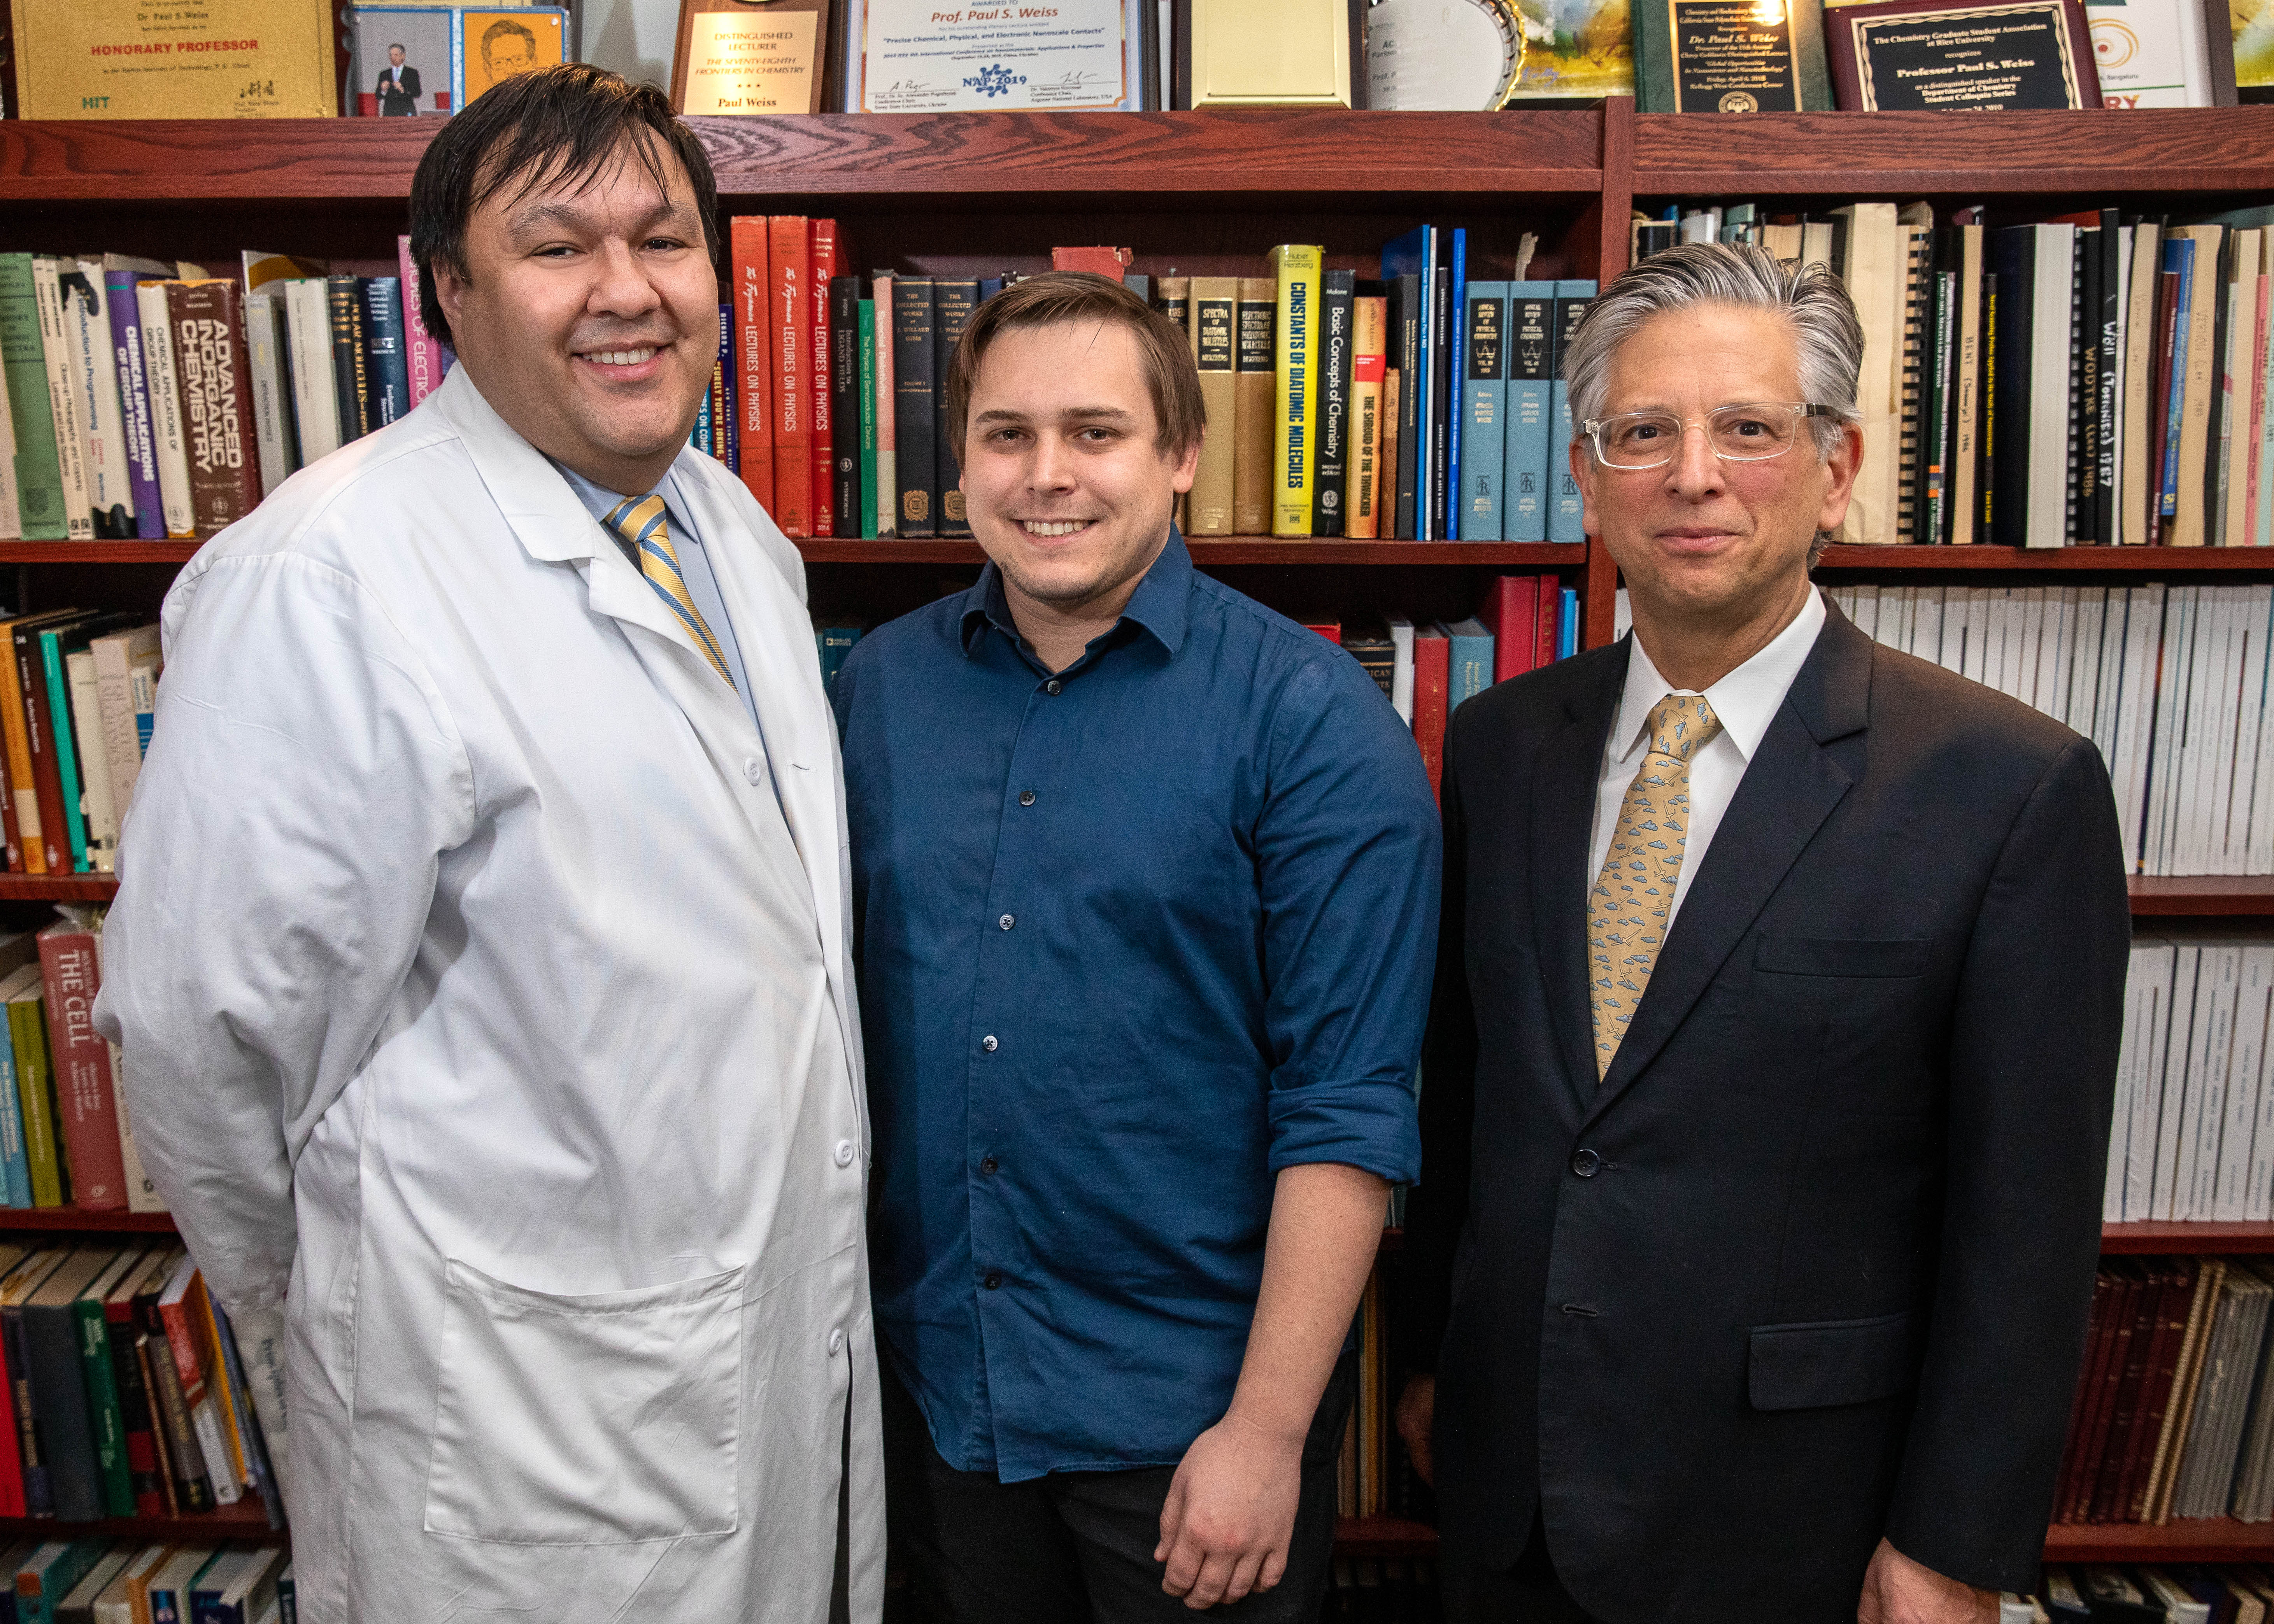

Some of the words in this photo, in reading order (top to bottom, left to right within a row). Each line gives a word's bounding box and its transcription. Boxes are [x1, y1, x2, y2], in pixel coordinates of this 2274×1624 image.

[154, 12, 172, 20] Paul
[931, 11, 963, 24] Prof.
[968, 9, 999, 21] Paul
[1002, 8, 1013, 19] S.
[1019, 6, 1059, 18] Weiss
[91, 43, 171, 56] HONORARY
[177, 39, 258, 53] PROFESSOR
[714, 32, 793, 41] DISTINGUISHED
[1689, 35, 1706, 44] Dr.
[1708, 34, 1734, 44] Paul
[1735, 34, 1746, 43] S.
[1750, 33, 1780, 42] Weiss
[1873, 37, 1889, 45] The
[1890, 34, 1930, 44] Chemistry
[1931, 30, 1969, 40] Graduate
[1970, 27, 2001, 37] Student
[2002, 23, 2047, 33] Association
[1936, 39, 1953, 47] Rice
[1955, 35, 1995, 45] University
[1897, 66, 1955, 78] Professor
[1957, 62, 1984, 73] Paul
[1985, 61, 1999, 70] S.
[2000, 58, 2035, 69] Weiss
[1945, 50, 1982, 59] recognizes
[695, 67, 742, 75] FRONTIERS
[756, 66, 805, 74] CHEMISTRY
[963, 75, 1027, 87] NAP-2019
[1929, 79, 1974, 91] distinguished
[1974, 77, 2000, 86] speaker
[82, 96, 110, 109] HIT
[718, 98, 742, 107] Paul
[747, 97, 777, 107] Weiss
[1922, 87, 1966, 96] Department
[1977, 82, 2016, 93] Chemistry
[1925, 95, 1954, 104] Student
[1992, 90, 2016, 98] Series
[743, 282, 758, 322] Feynman
[782, 283, 797, 324] Feynman
[814, 283, 828, 323] Feynman
[1203, 308, 1228, 319] SPECTRA
[1290, 282, 1306, 349] CONSTANTS
[77, 295, 89, 356] Introduction
[412, 314, 427, 337] OF
[877, 311, 886, 347] Special
[1331, 307, 1344, 335] Basic
[117, 347, 128, 365] OF
[125, 326, 143, 390] CHEMICAL
[147, 328, 158, 359] GROUP
[721, 349, 728, 357] P.
[745, 326, 758, 371] LECTURES
[783, 326, 796, 372] LECTURES
[815, 326, 828, 371] LECTURES
[838, 329, 846, 361] LIGAND
[1289, 352, 1306, 365] OF
[1965, 336, 1974, 364] BENT
[84, 357, 91, 366] to
[862, 348, 871, 371] Physics
[877, 351, 887, 399] Relativity
[1327, 336, 1343, 388] Concepts
[119, 366, 134, 411] GROUP
[150, 361, 160, 395] THEORY
[156, 327, 168, 370] CHEMICAL
[162, 376, 176, 437] APPLICATIONS
[170, 439, 179, 451] OF
[713, 361, 722, 394] “SURELY
[747, 375, 759, 389] ON
[784, 375, 796, 389] ON
[815, 375, 827, 388] ON
[846, 376, 852, 384] to
[2084, 346, 2097, 416] WODTKE
[85, 368, 99, 431] Programming
[181, 319, 212, 474] CHEMISTRY
[197, 320, 226, 467] INORGANIC
[214, 320, 243, 469] ADVANCED
[1288, 367, 1306, 422] DIATOMIC
[1329, 389, 1342, 402] of
[1364, 396, 1375, 412] THE
[699, 415, 708, 427] ON
[747, 392, 761, 431] PHYSICS
[784, 392, 797, 432] PHYSICS
[815, 391, 828, 431] PHYSICS
[124, 412, 140, 462] THEORY
[133, 392, 155, 482] APPLICATIONS
[715, 427, 725, 457] JOKING,
[1324, 403, 1341, 458] Chemistry
[1362, 412, 1374, 444] SHROUD
[1287, 425, 1304, 489] MOLECULES
[1361, 458, 1373, 473] THE
[1362, 446, 1373, 457] OF
[2099, 452, 2114, 487] 1987
[1359, 475, 1372, 517] THWACKER
[58, 950, 84, 992] THE
[64, 996, 90, 1048] CELL
